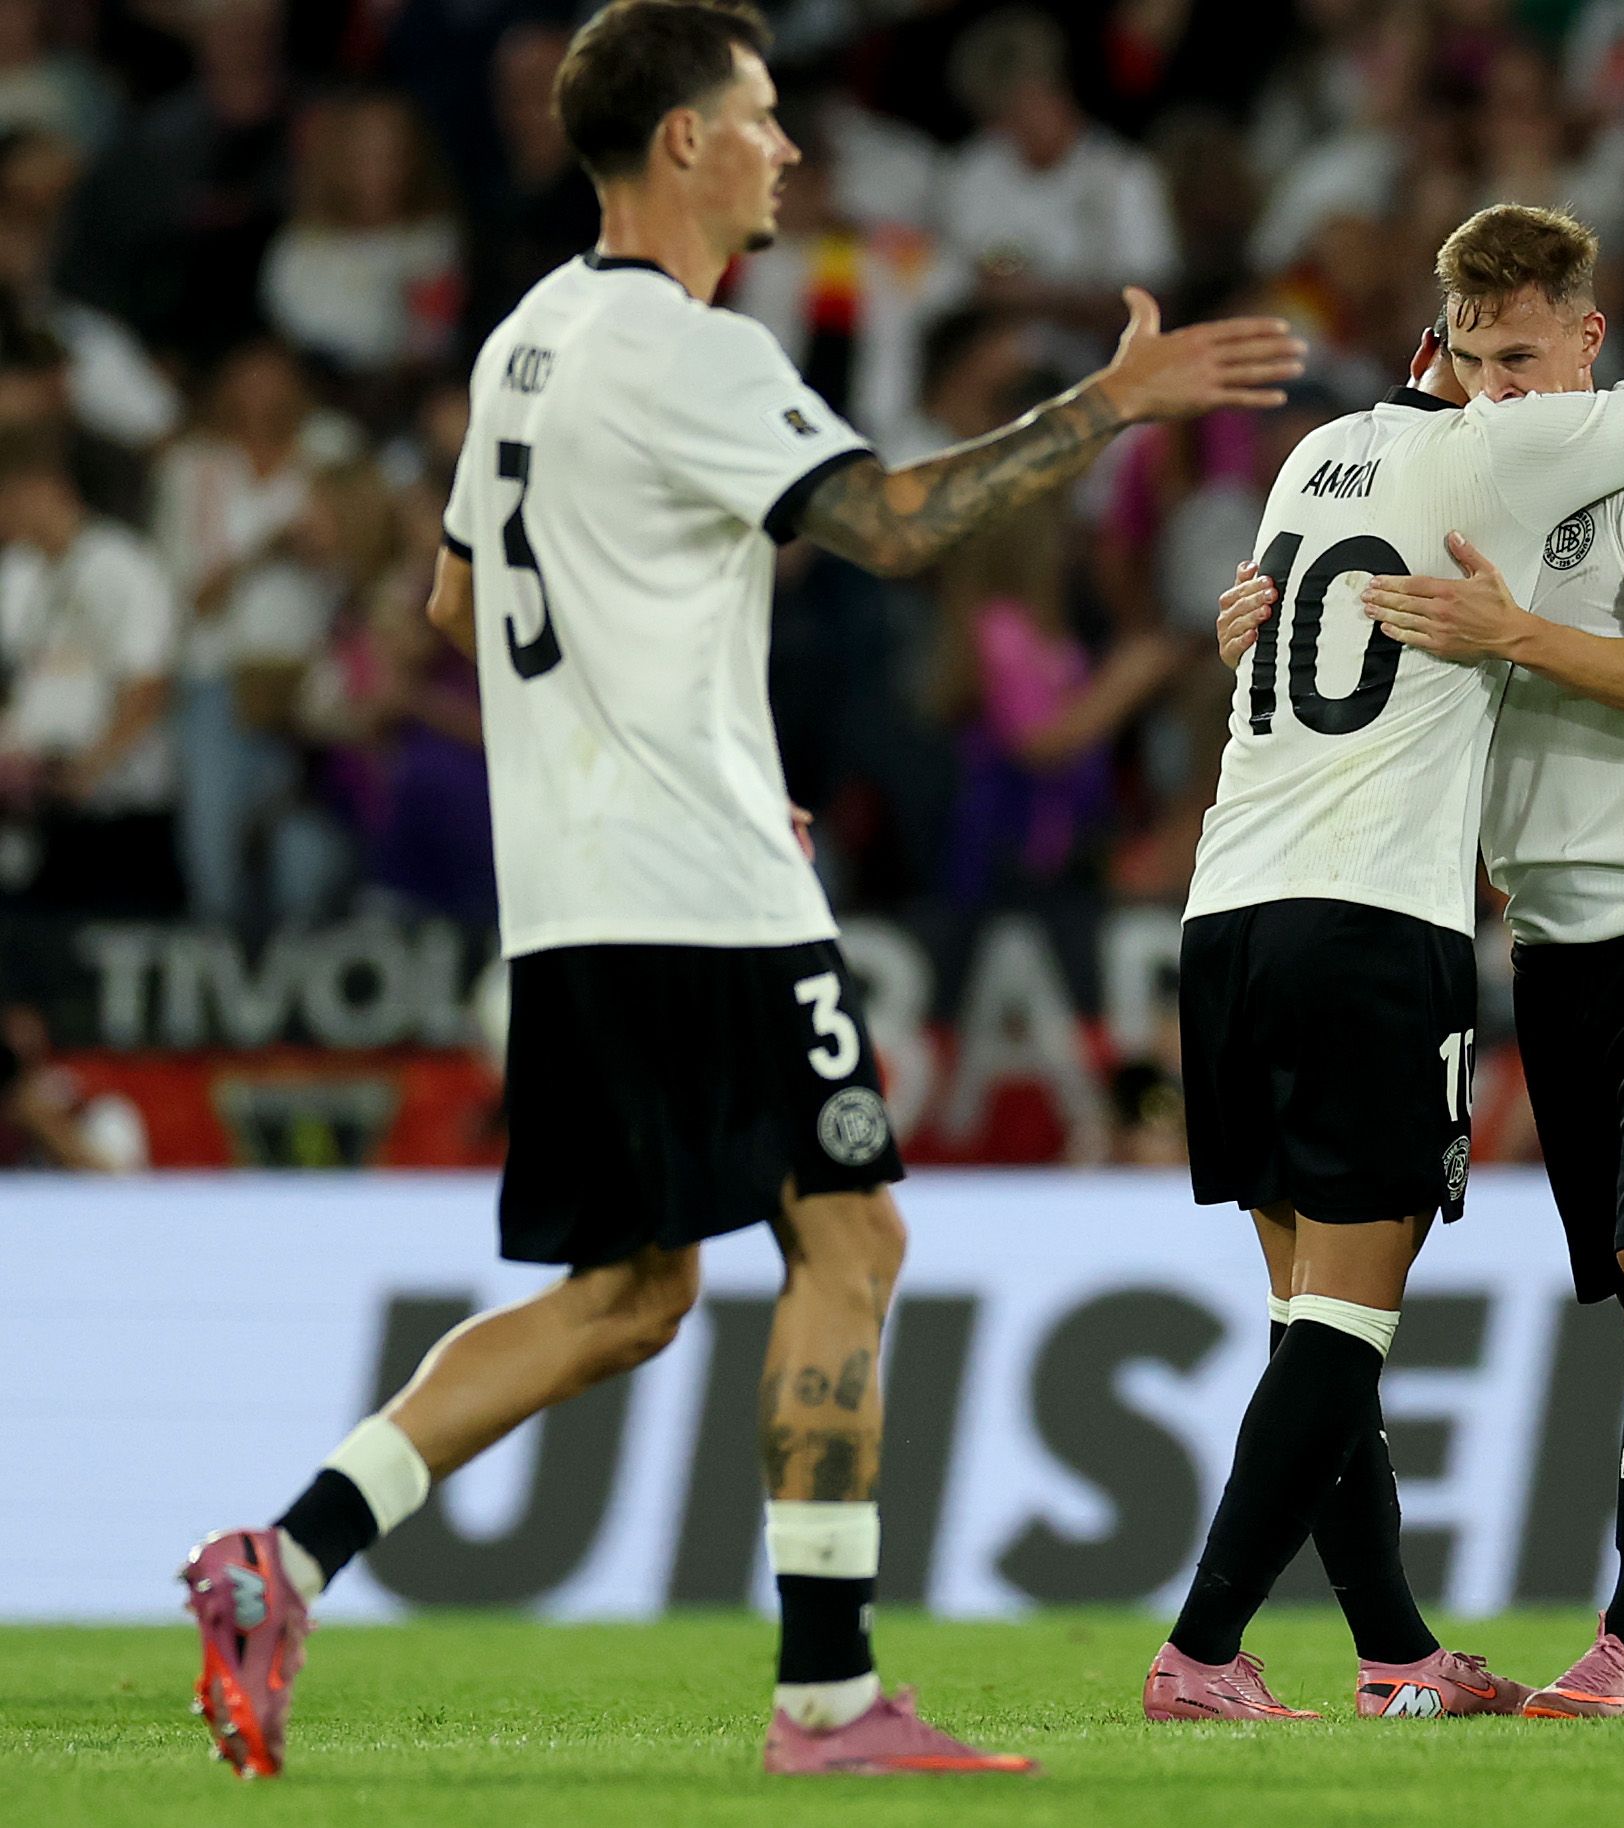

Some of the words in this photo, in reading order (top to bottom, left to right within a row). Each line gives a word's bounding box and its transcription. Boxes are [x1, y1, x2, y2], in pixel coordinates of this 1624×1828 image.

[500, 345, 553, 393] KOC
[1301, 458, 1381, 498] AMIRI
[496, 440, 562, 680] 3
[1249, 531, 1411, 735] 10
[794, 971, 860, 1080] 3
